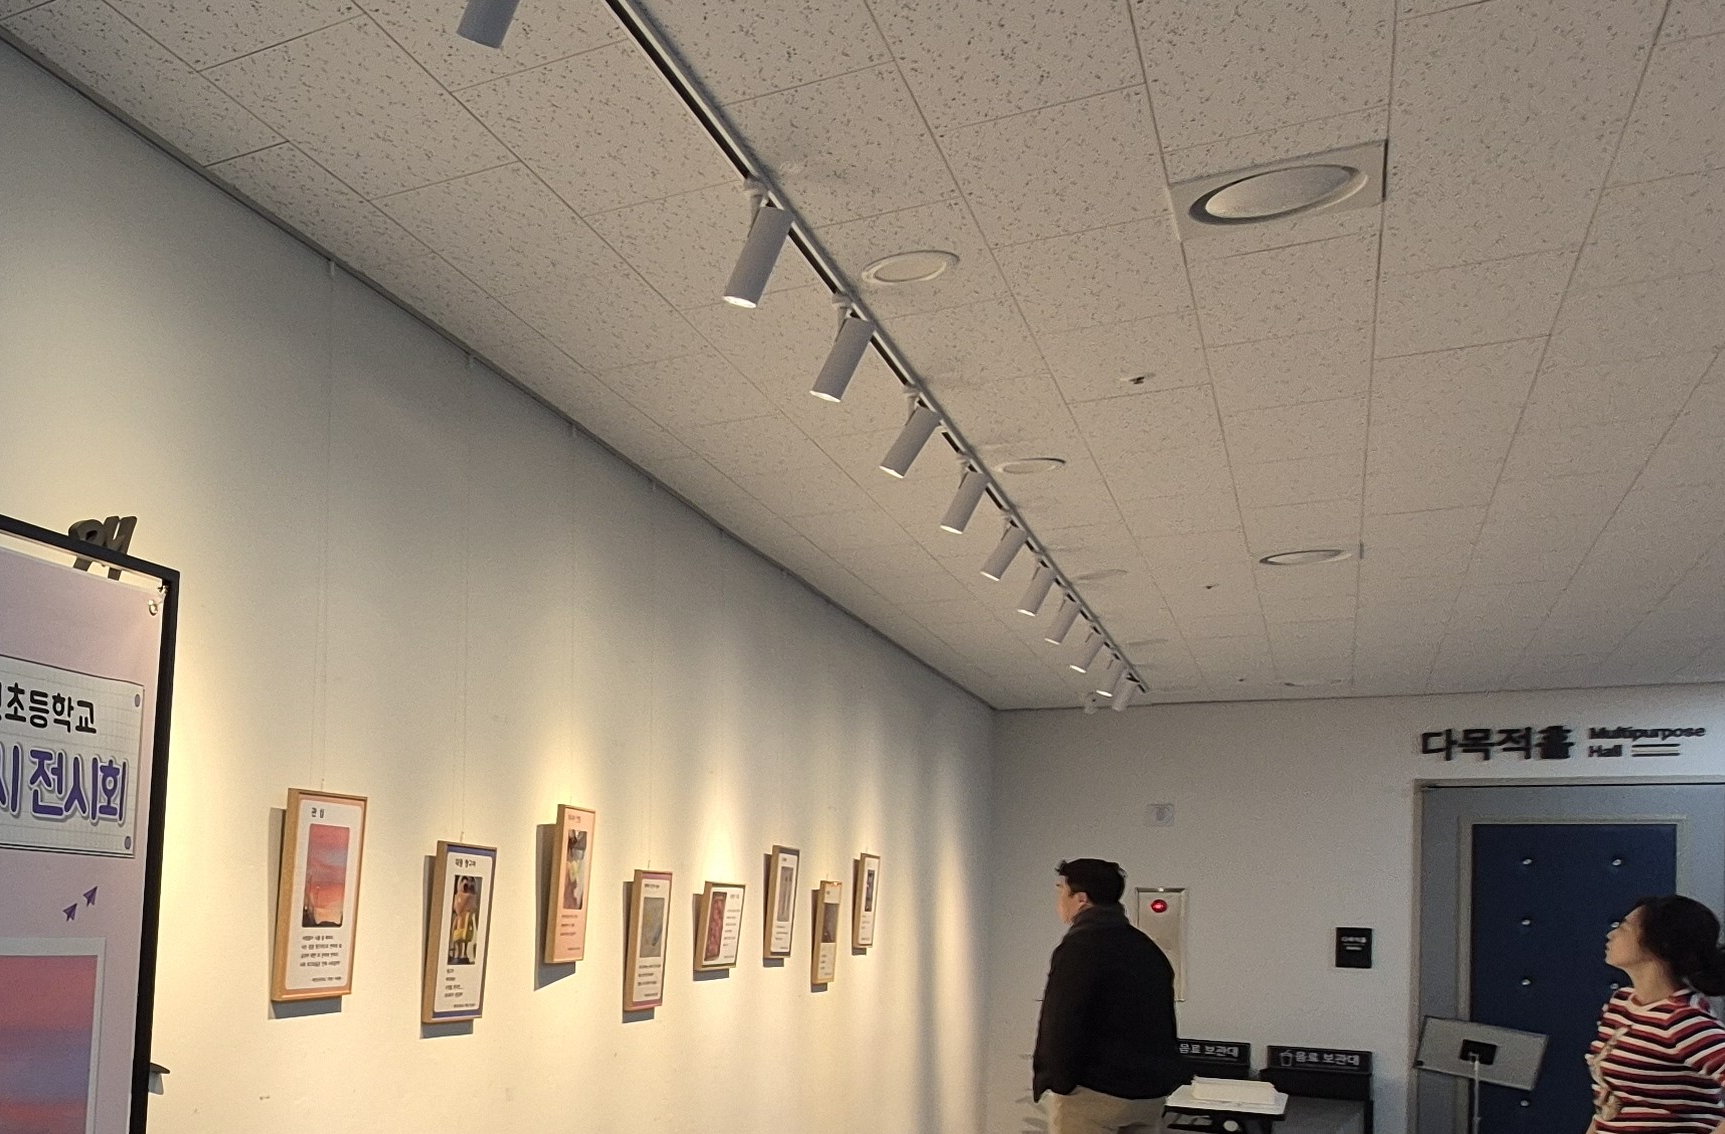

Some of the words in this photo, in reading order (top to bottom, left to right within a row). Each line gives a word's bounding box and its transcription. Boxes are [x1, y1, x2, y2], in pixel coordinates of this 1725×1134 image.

[1421, 725, 1575, 761] 다목적홀
[1588, 726, 1706, 742] Multipurpose
[28, 747, 128, 824] 전시회
